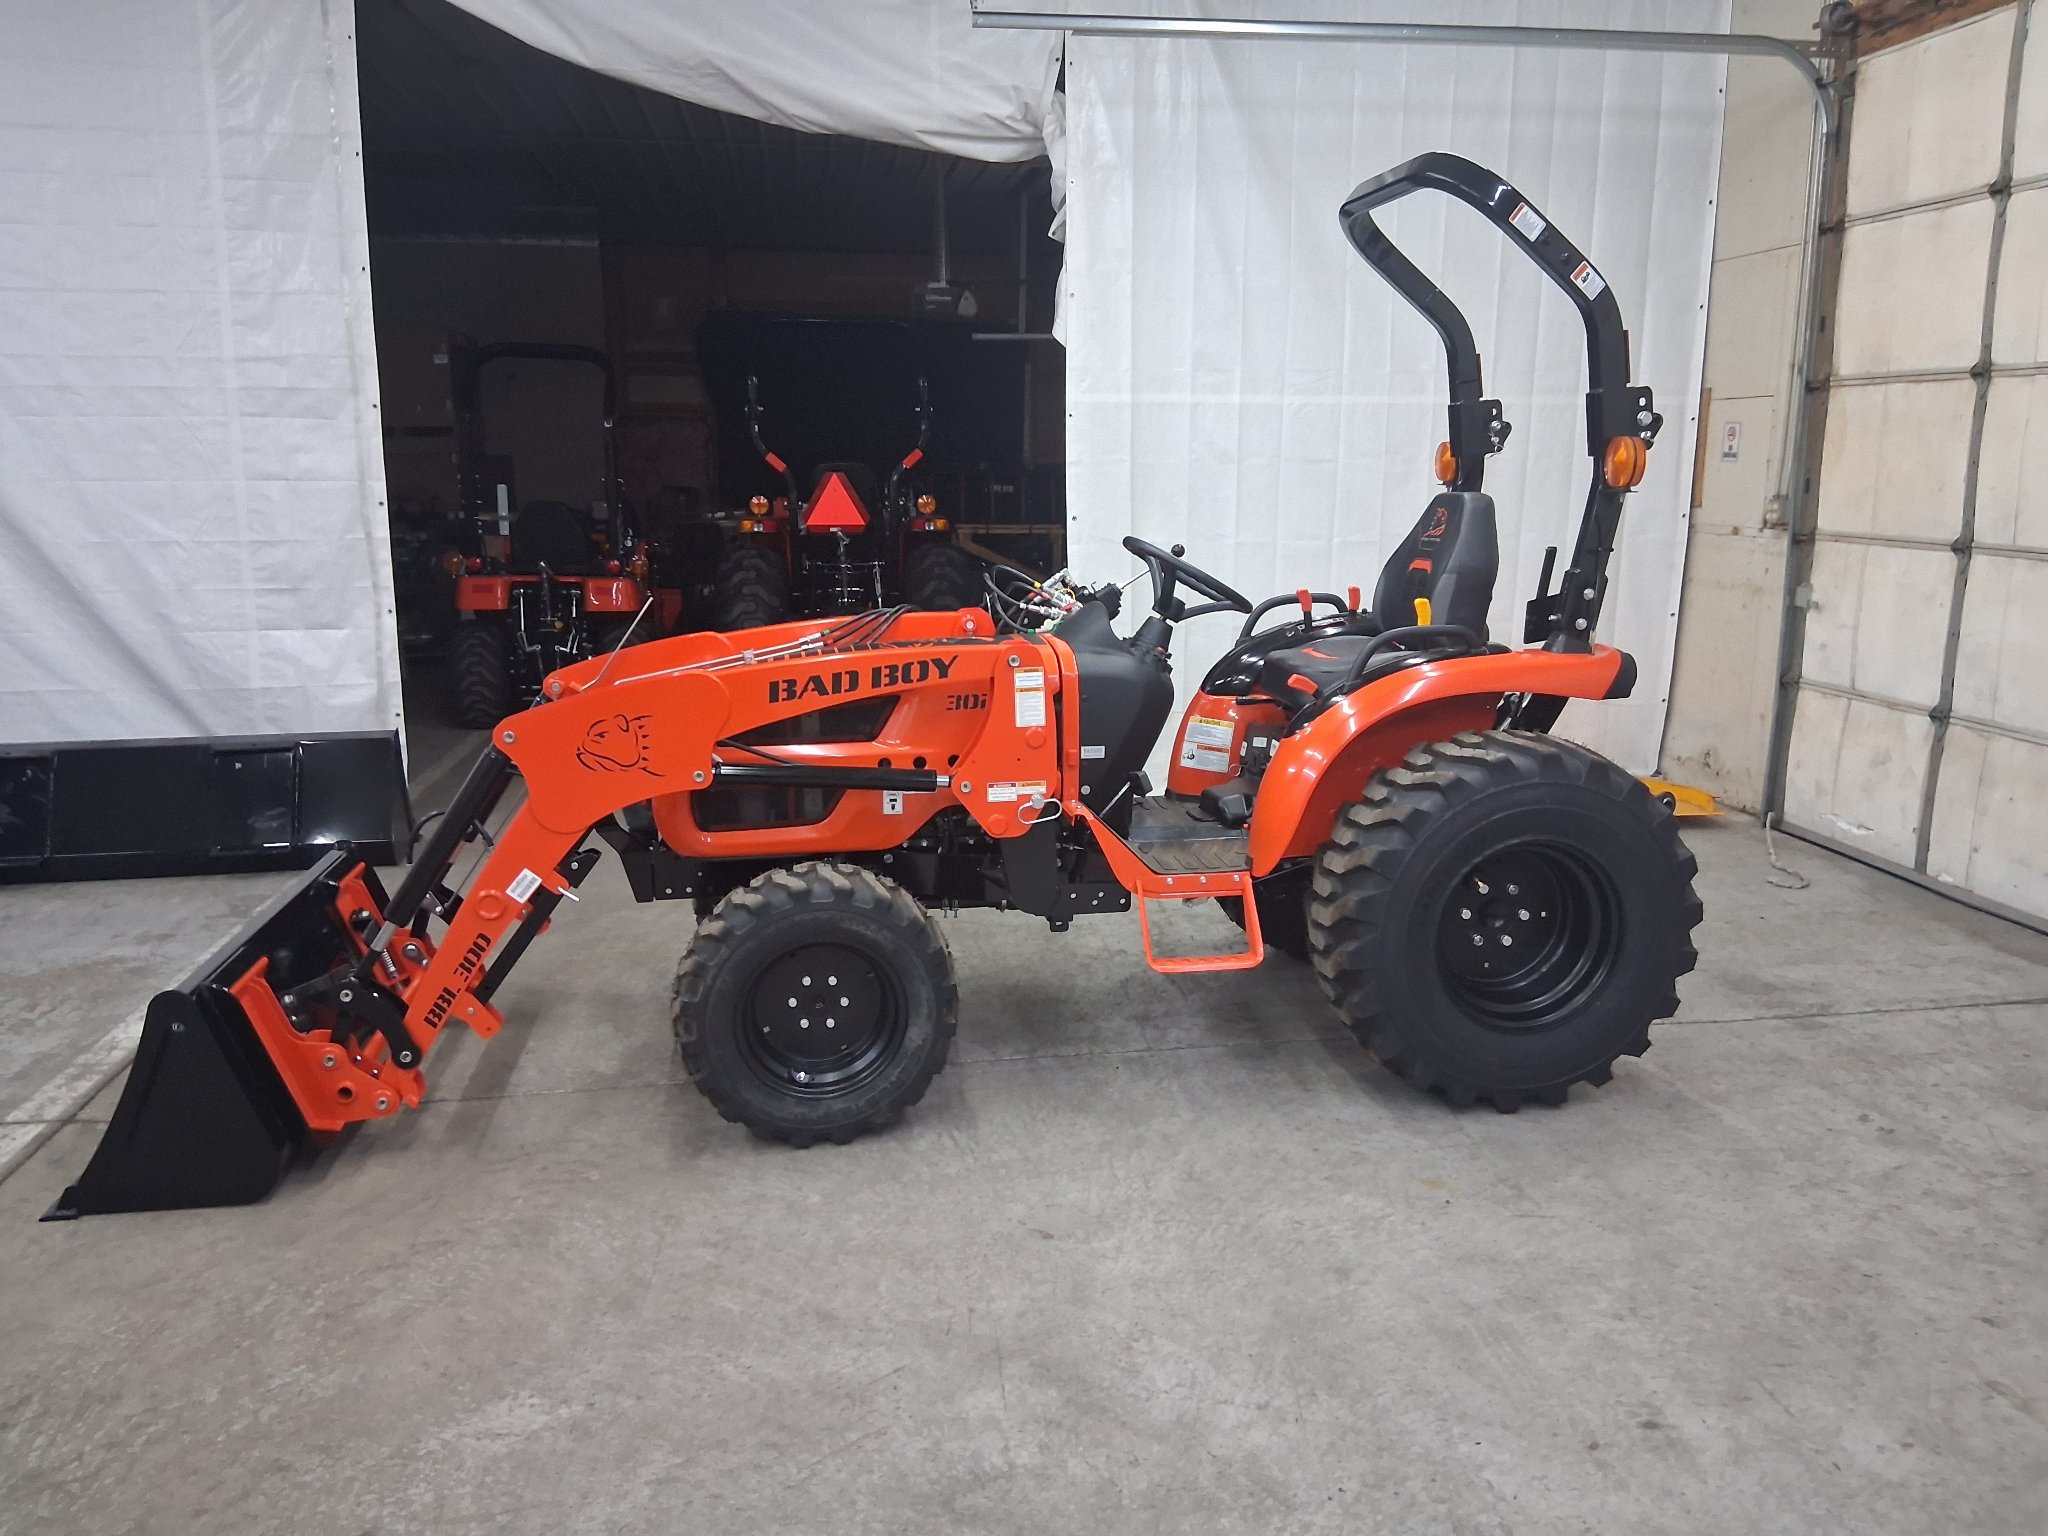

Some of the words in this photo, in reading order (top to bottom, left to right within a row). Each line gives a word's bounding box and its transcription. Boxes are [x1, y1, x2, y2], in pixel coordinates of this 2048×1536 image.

[769, 670, 860, 704] BAD
[871, 655, 959, 688] BOY
[946, 693, 988, 711] 30i
[424, 987, 460, 1029] BBL
[453, 932, 491, 982] 300
